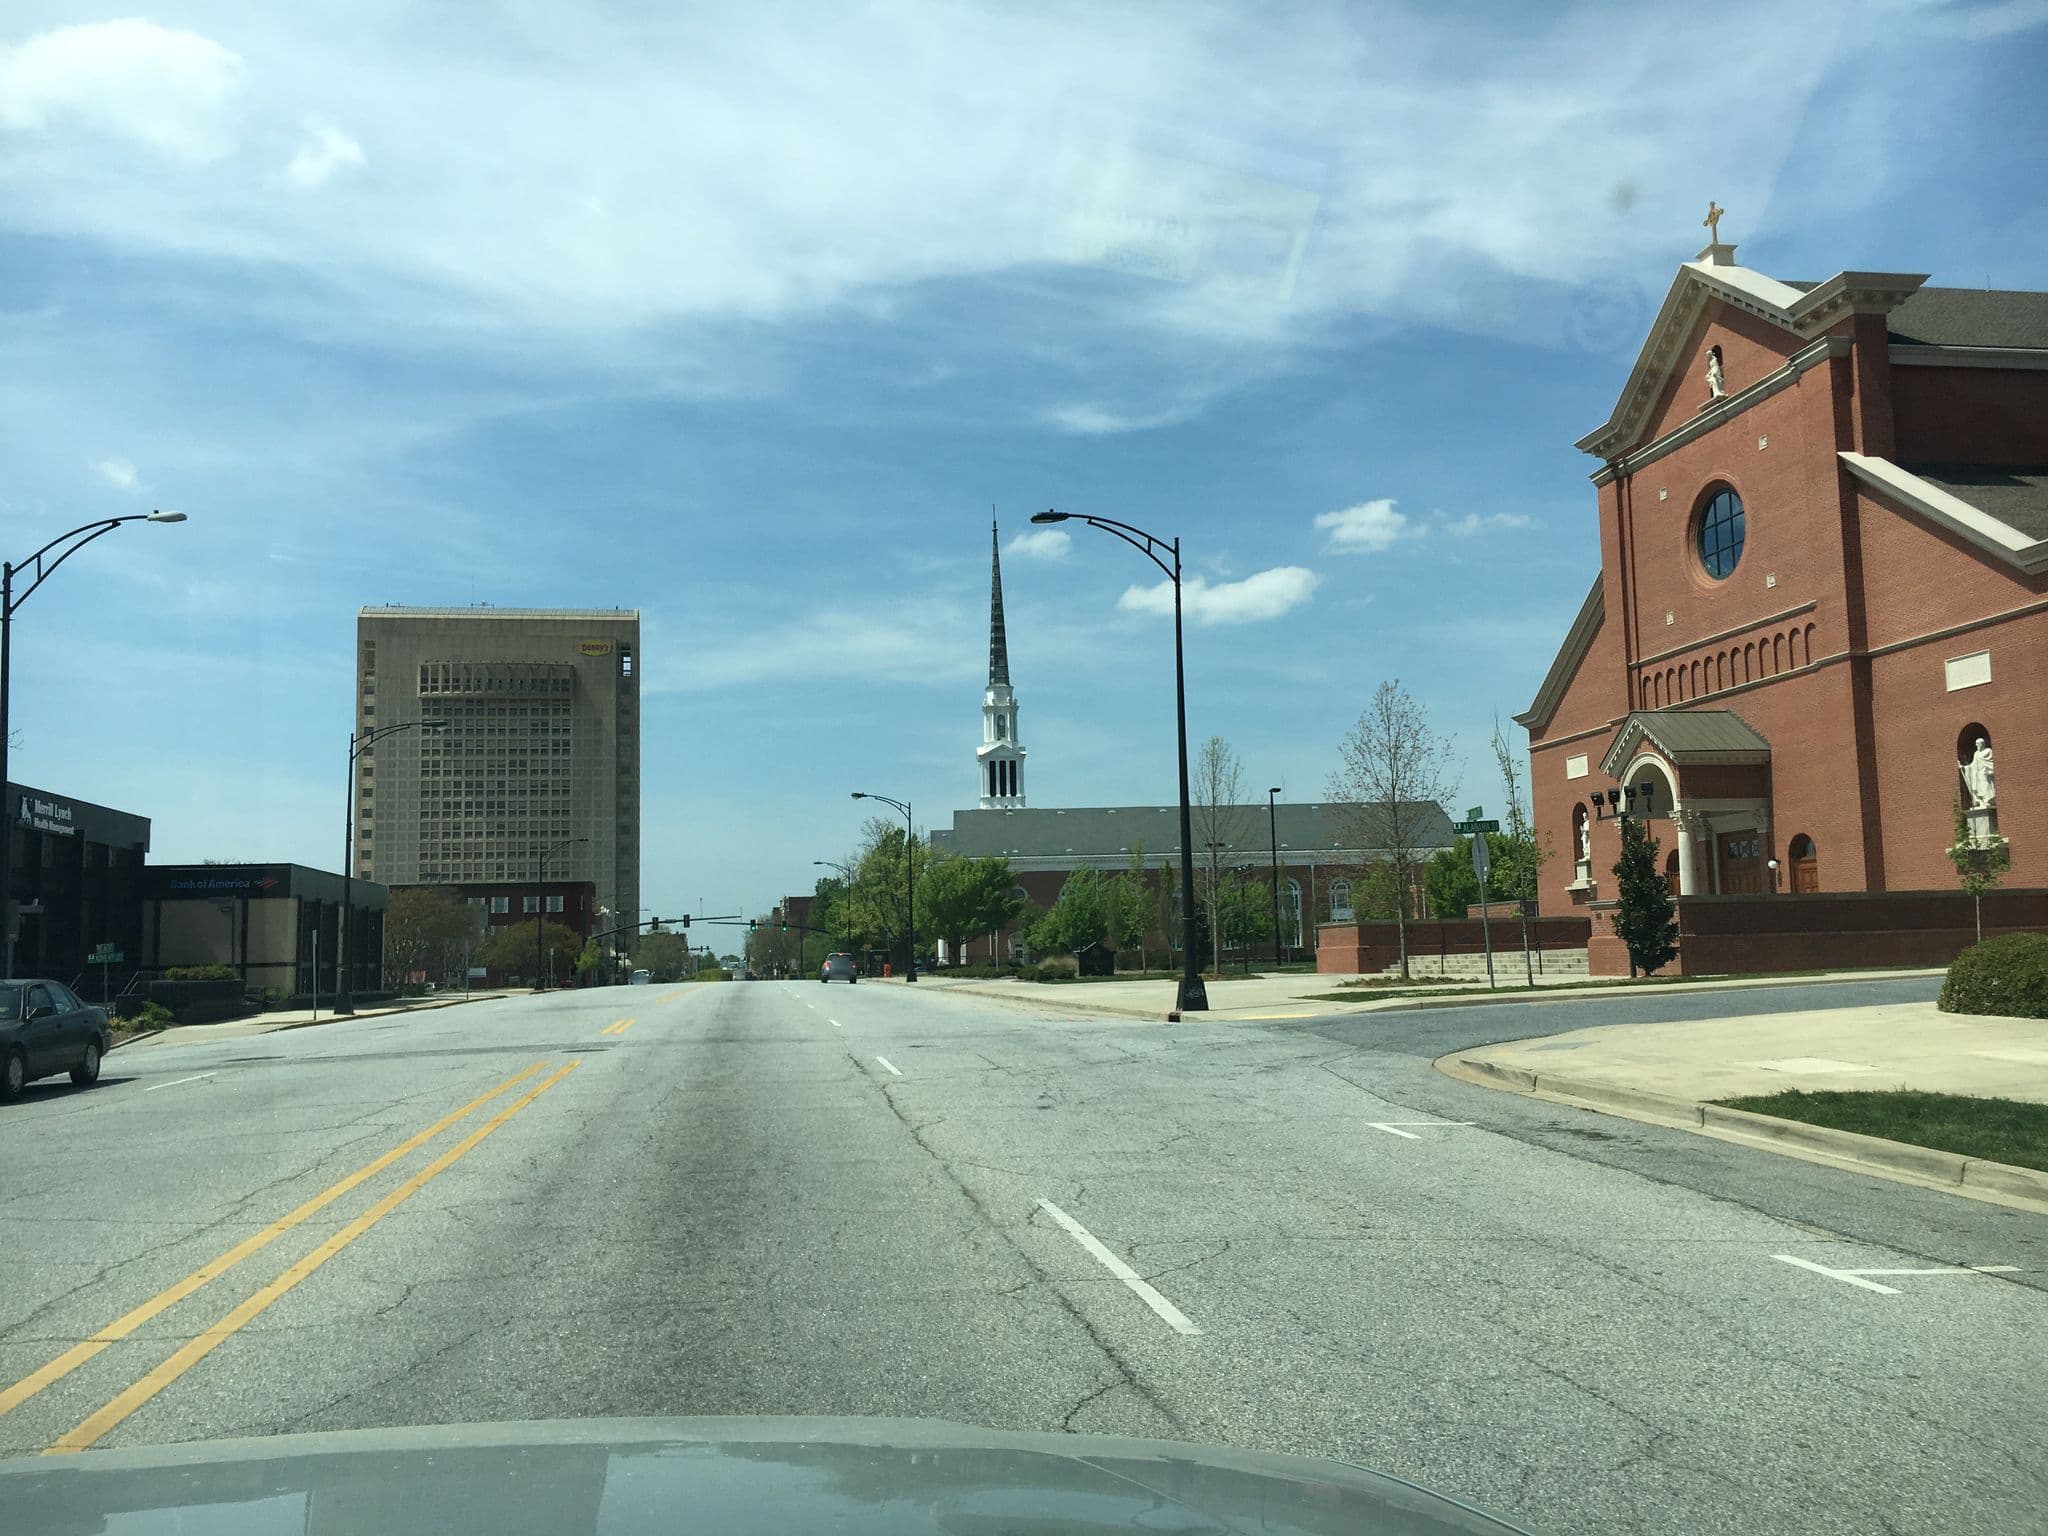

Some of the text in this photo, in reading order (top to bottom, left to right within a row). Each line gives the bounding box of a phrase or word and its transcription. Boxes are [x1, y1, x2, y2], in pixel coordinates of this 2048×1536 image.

[582, 643, 608, 653] Denny's
[35, 799, 72, 821] Merrill Lynch
[1463, 822, 1491, 832] ALABAMA
[170, 879, 251, 889] Bank of America
